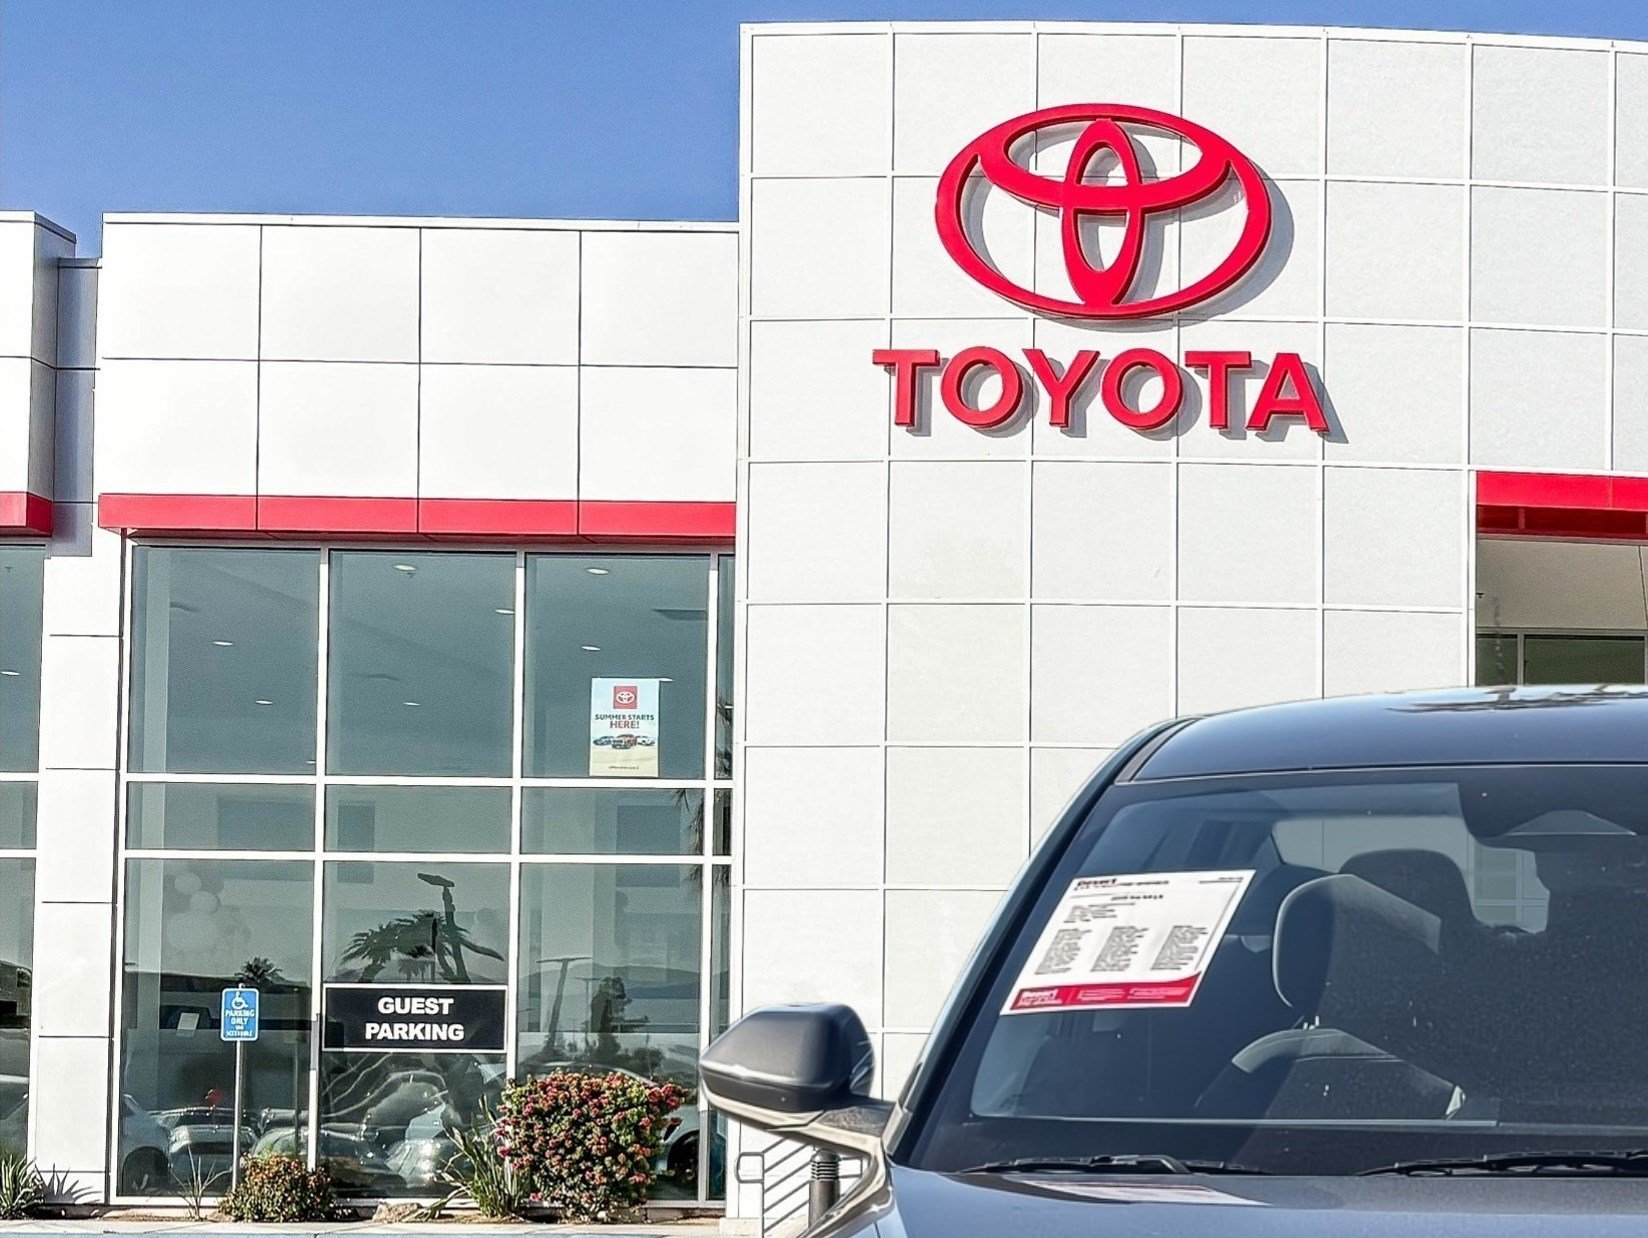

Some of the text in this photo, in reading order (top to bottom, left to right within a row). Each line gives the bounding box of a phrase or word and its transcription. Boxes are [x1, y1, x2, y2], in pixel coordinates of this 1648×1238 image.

[872, 346, 1330, 432] TOYOTA
[609, 720, 640, 729] HERE!
[377, 997, 455, 1015] GUEST
[231, 1016, 249, 1025] ONLY
[365, 1022, 464, 1041] PARKING
